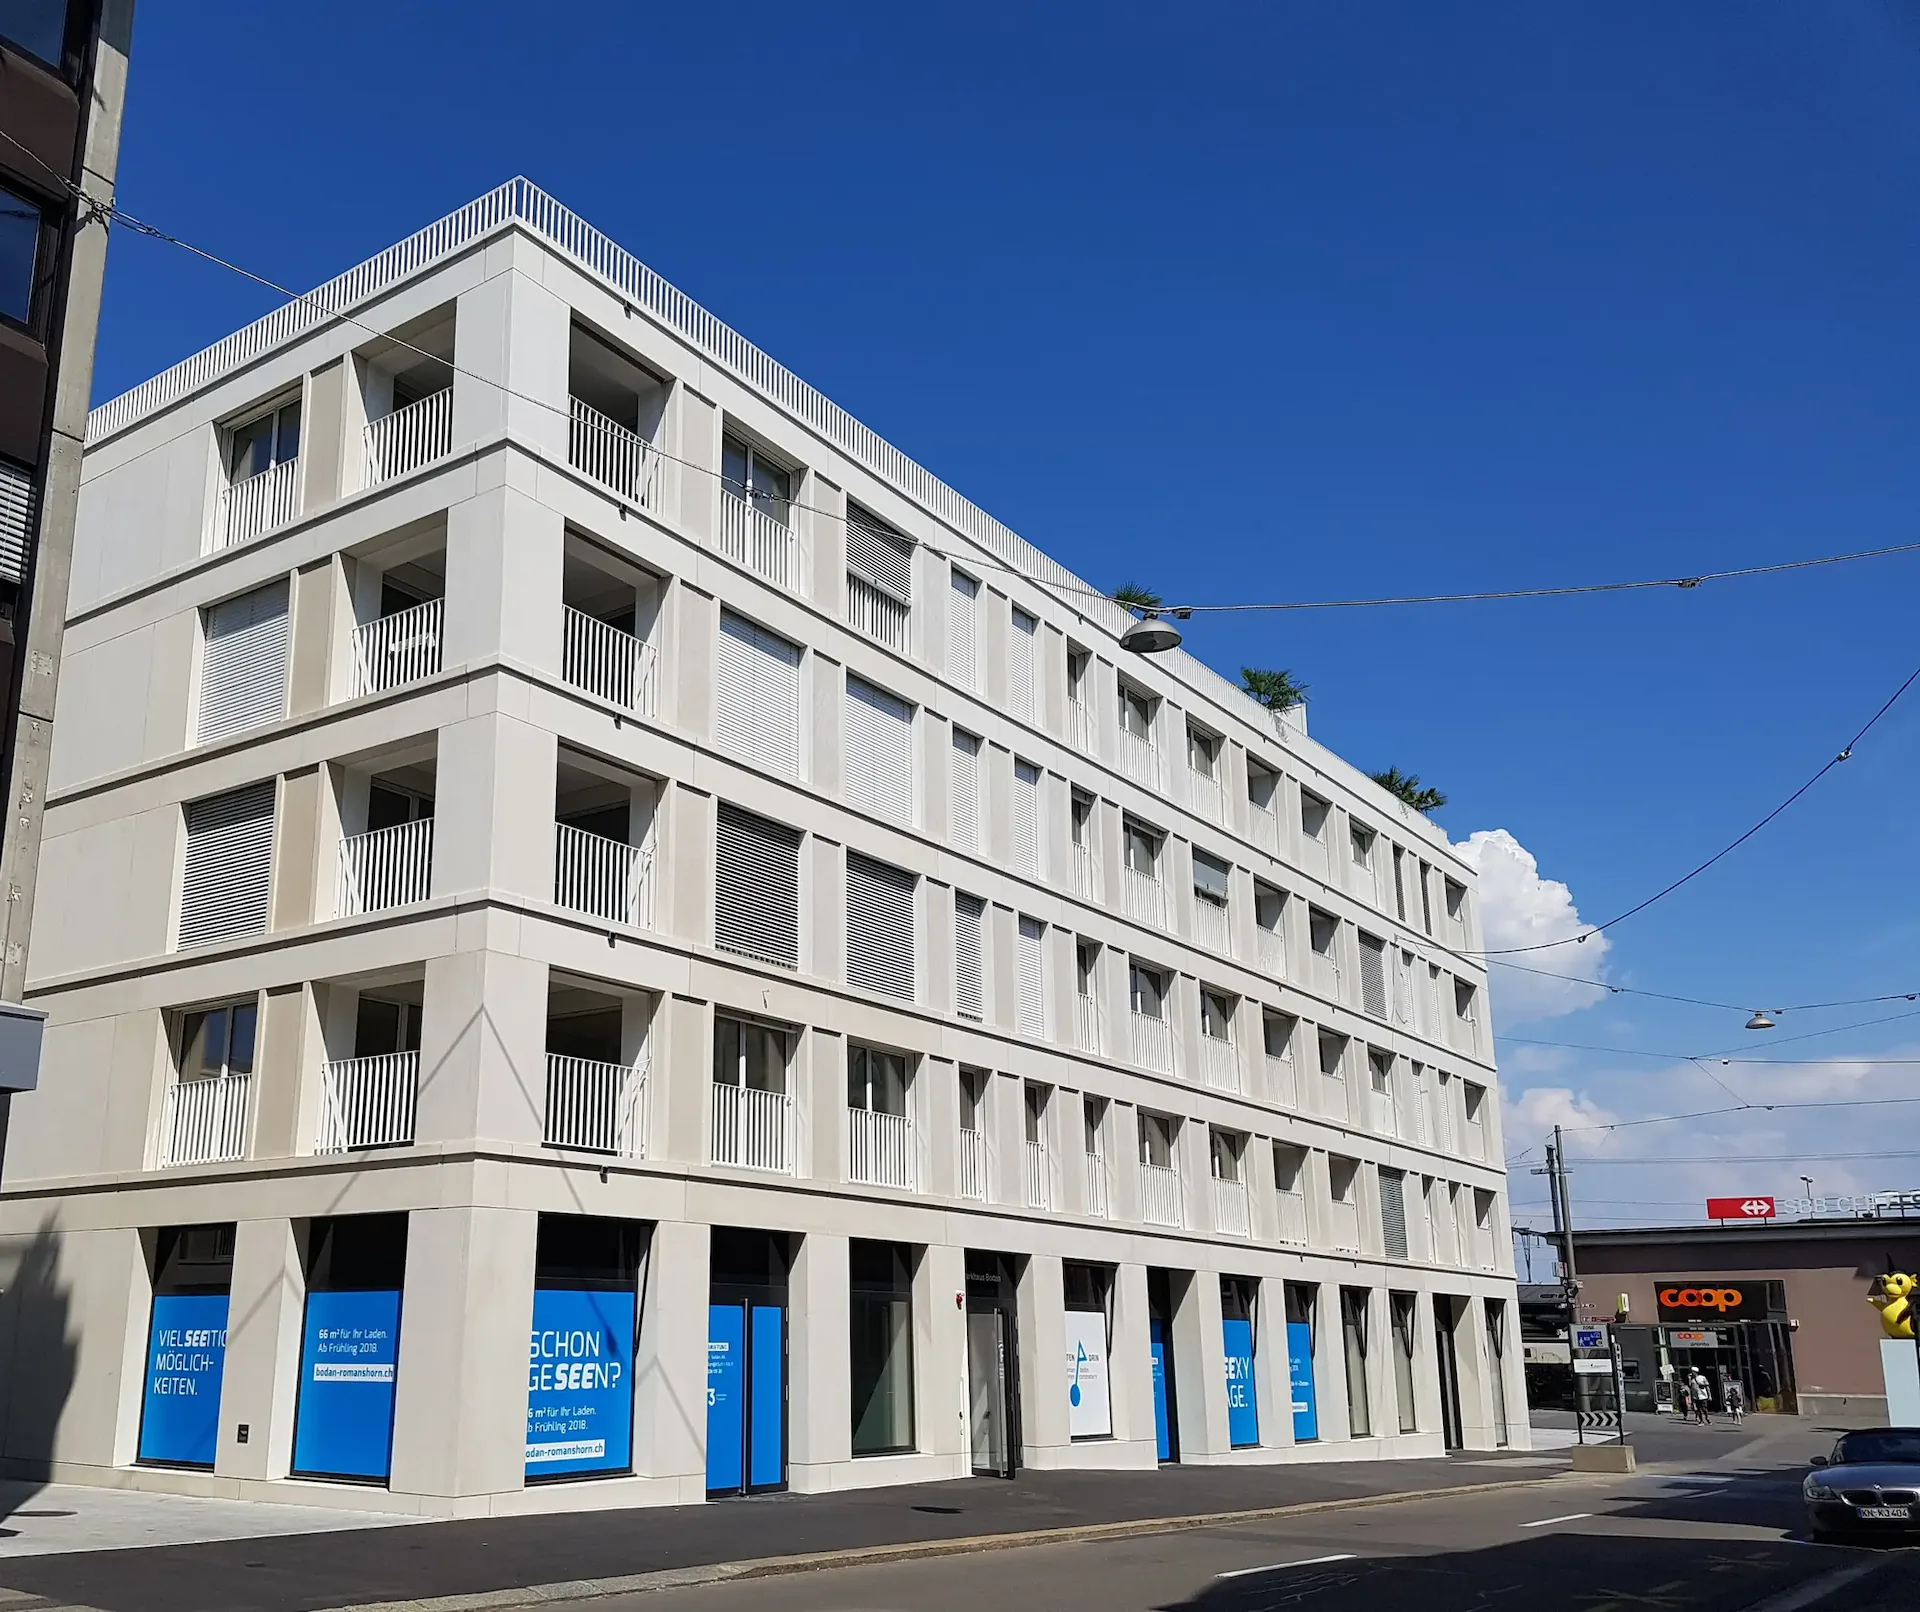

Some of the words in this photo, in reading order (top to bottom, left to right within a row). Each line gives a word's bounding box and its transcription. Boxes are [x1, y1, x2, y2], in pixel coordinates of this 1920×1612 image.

[1785, 1198, 1828, 1214] SBB
[1660, 1288, 1742, 1312] coop
[318, 1329, 329, 1339] 66
[340, 1328, 351, 1339] für
[352, 1328, 363, 1339] Ihr
[364, 1328, 388, 1339] Laden.
[317, 1342, 328, 1353] Ab
[328, 1342, 358, 1356] Frühling
[359, 1342, 379, 1353] 2018.
[529, 1330, 600, 1358] SCHON
[155, 1350, 214, 1372] MÖGLICH-
[315, 1366, 393, 1378] bodan-romanshorn.ch
[528, 1361, 621, 1391] GESEEN?
[153, 1376, 198, 1396] KEITEN.
[547, 1406, 559, 1418] für
[560, 1405, 571, 1417] Ihr
[572, 1405, 597, 1417] Laden.
[534, 1421, 567, 1434] Frühling
[568, 1419, 588, 1431] 2018.
[525, 1442, 603, 1458] odan-romanshorn.ch
